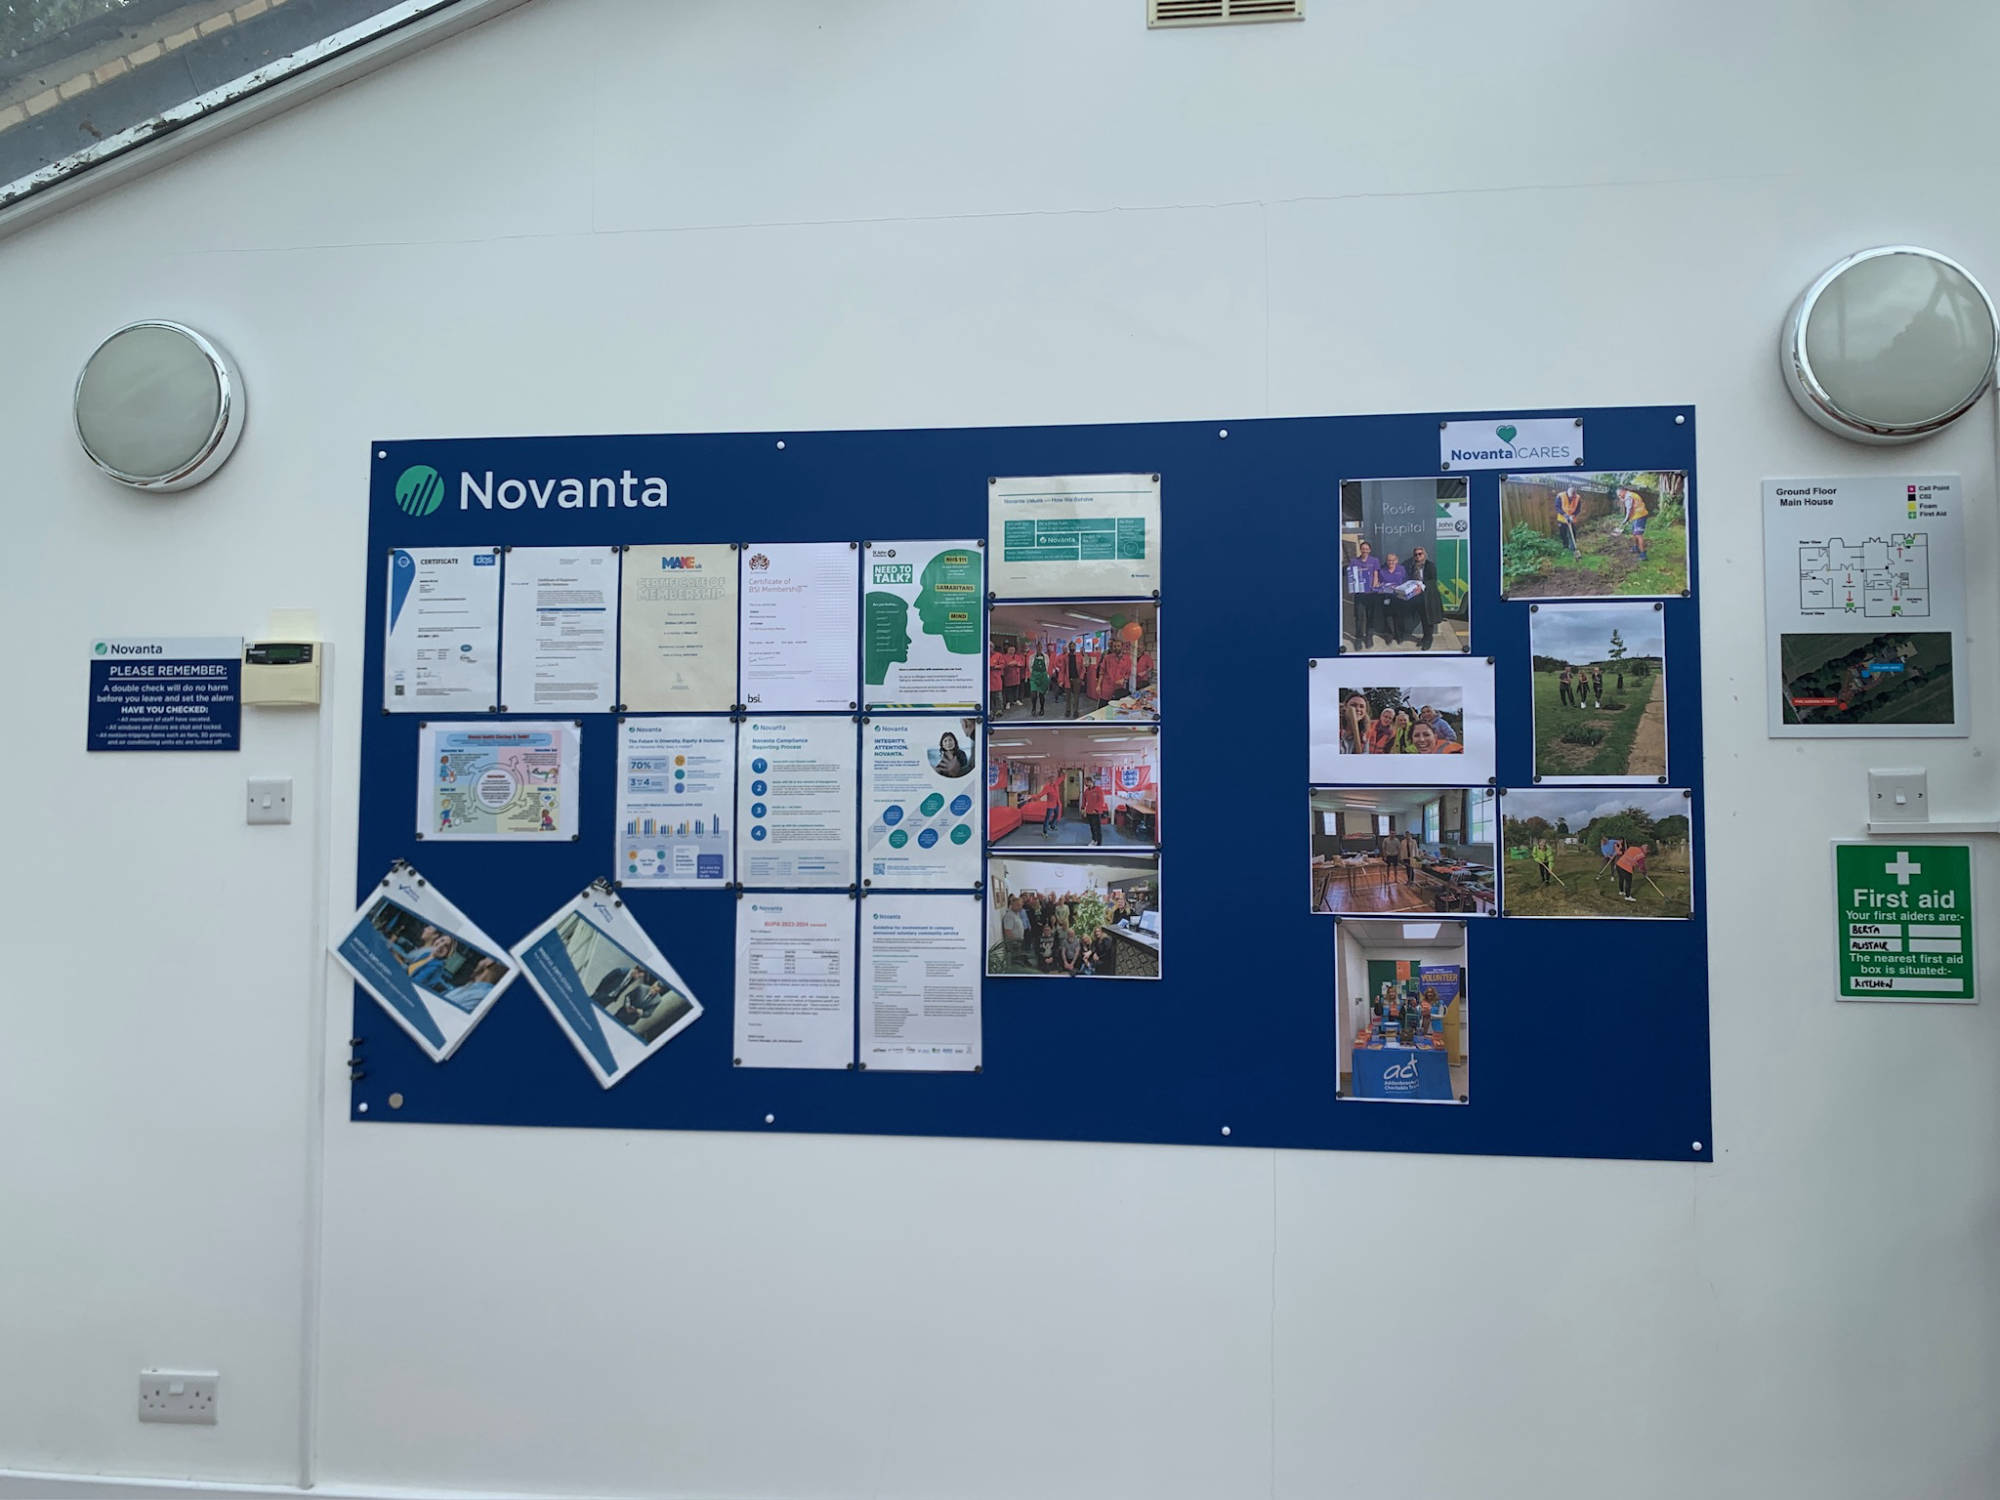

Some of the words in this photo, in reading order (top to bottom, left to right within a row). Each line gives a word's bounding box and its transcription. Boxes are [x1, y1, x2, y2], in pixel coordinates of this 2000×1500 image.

[1451, 450, 1513, 461] Novanta
[1517, 446, 1570, 459] CARES
[460, 470, 668, 510] Novanta
[1776, 488, 1809, 496] Ground
[1812, 487, 1837, 495] Floor
[1780, 498, 1802, 506] Main
[1805, 497, 1834, 506] House
[1382, 502, 1416, 514] Rosie
[1374, 521, 1425, 537] Hospital
[662, 556, 695, 569] MAKE
[875, 566, 898, 574] NEED
[875, 574, 911, 583] TALK?
[111, 644, 163, 655] Novanta
[110, 666, 154, 676] PLEASE
[158, 665, 227, 676] REMEMBER:
[111, 684, 138, 692] double
[1854, 888, 1909, 908] First
[1919, 890, 1955, 908] aid
[1846, 910, 1871, 920] Your
[1874, 911, 1897, 920] first
[1900, 912, 1935, 921] aiders
[1939, 913, 1965, 921] are:-
[1852, 925, 1880, 935] BERTA
[1849, 953, 1870, 962] The
[1874, 954, 1917, 963] nearest
[1920, 954, 1943, 963] first
[1946, 955, 1964, 964] aid
[1860, 964, 1881, 973] box
[1885, 965, 1895, 974] is
[1899, 966, 1952, 975] situated:-
[1854, 979, 1893, 988] KITCHEN
[1383, 1052, 1418, 1080] act
